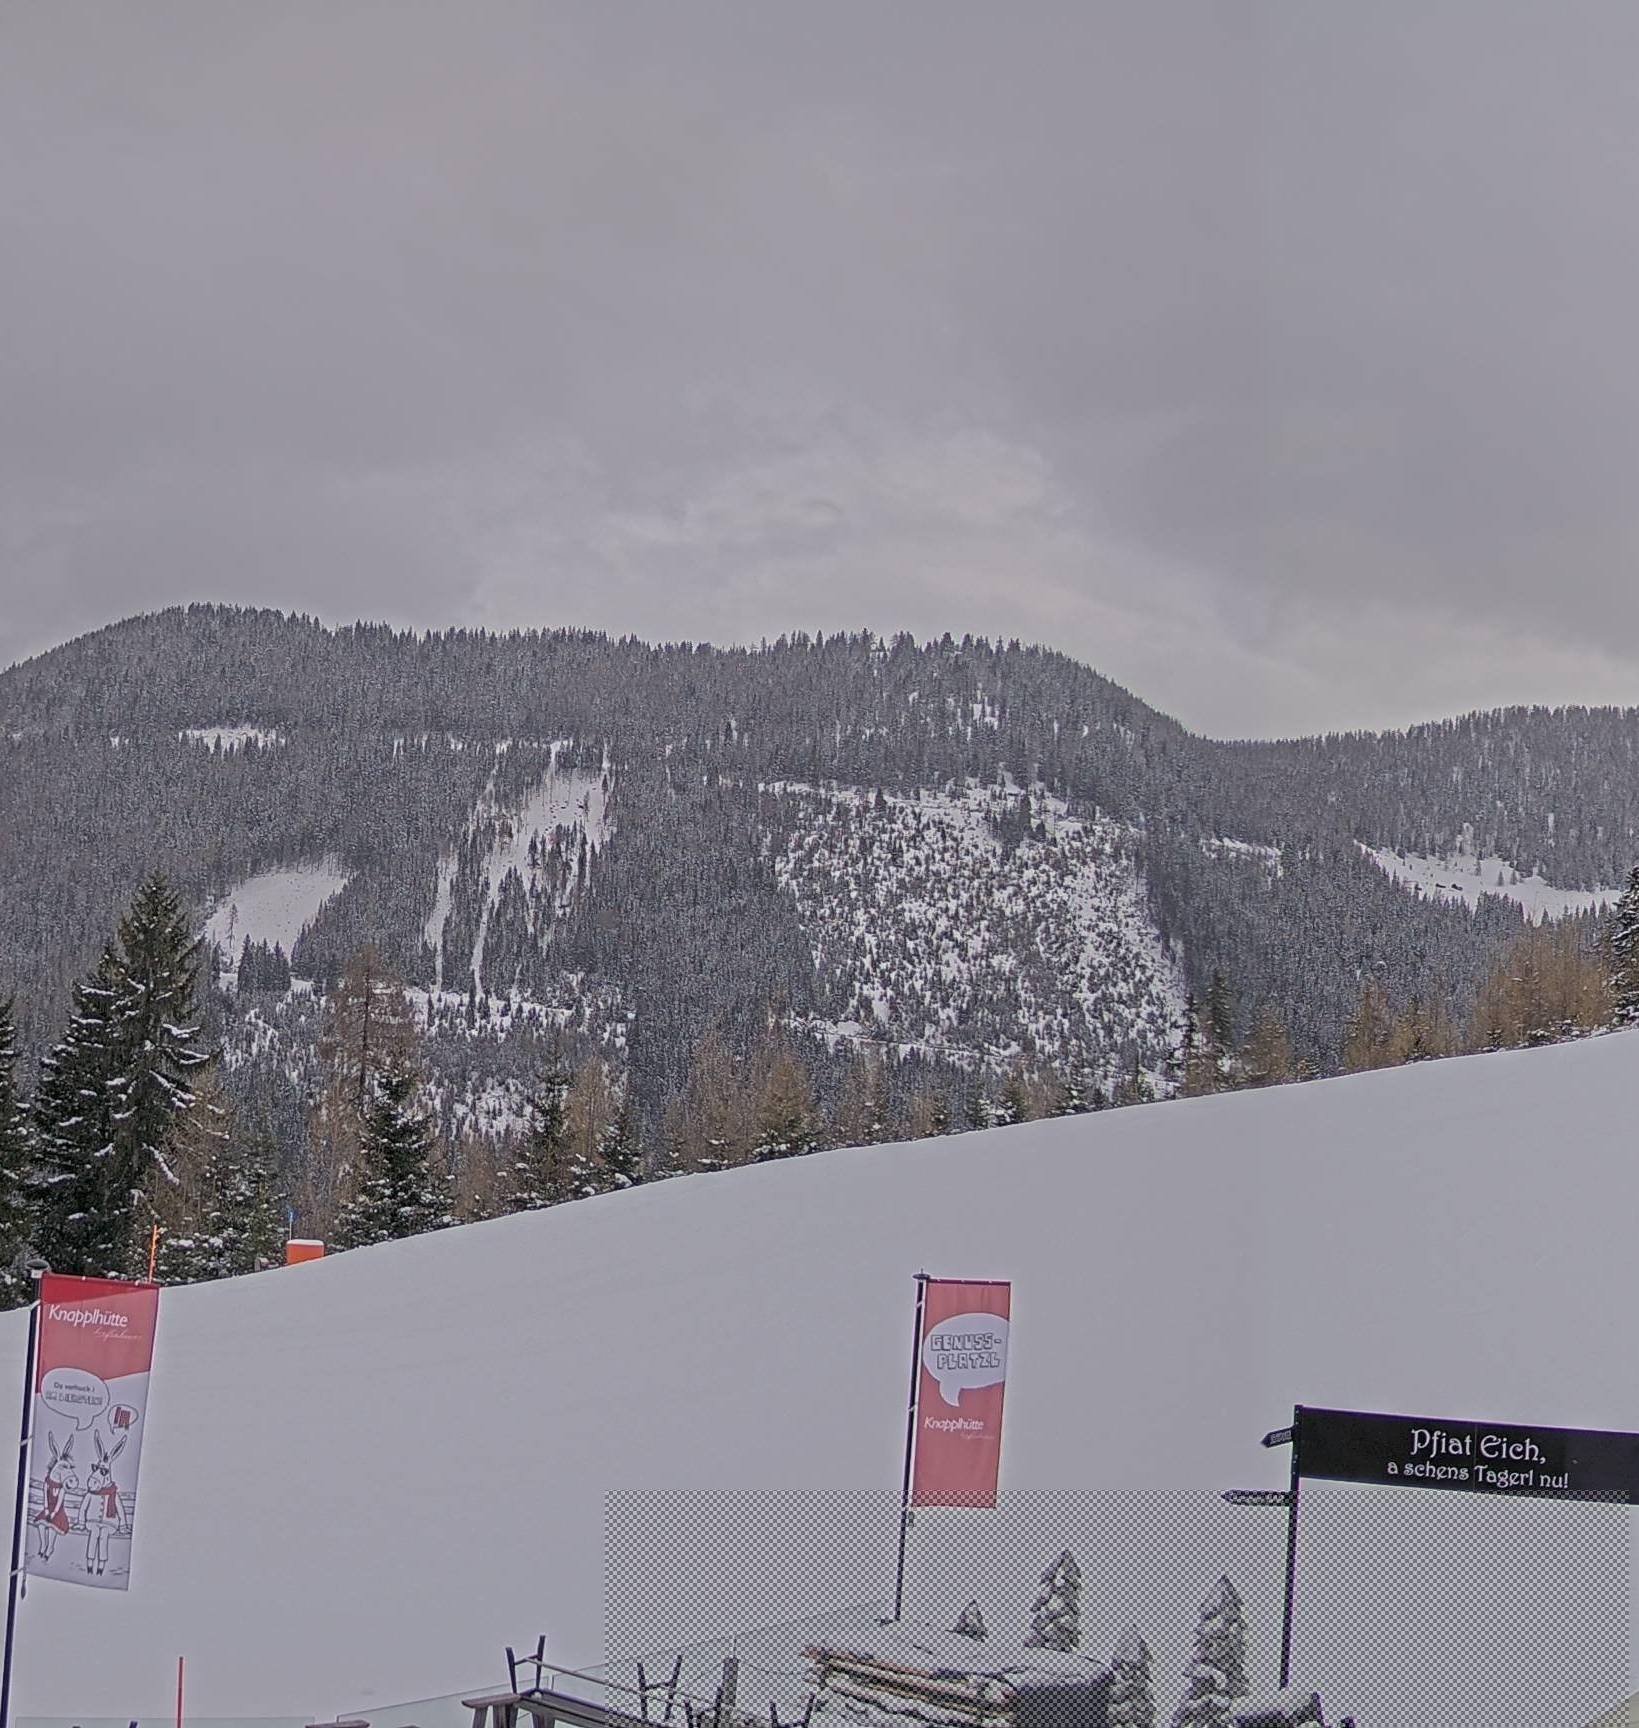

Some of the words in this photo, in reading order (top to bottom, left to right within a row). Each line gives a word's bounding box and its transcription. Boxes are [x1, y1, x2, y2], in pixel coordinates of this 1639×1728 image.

[49, 1304, 128, 1327] Knapplhütte
[931, 1333, 1002, 1351] GENUSS-
[937, 1352, 1000, 1370] PLATZL
[924, 1417, 984, 1432] Knapplhütte
[1410, 1429, 1472, 1458] Pfiat
[1480, 1434, 1547, 1464] Eich,
[1387, 1462, 1398, 1475] a
[1403, 1461, 1470, 1481] schens
[1474, 1465, 1534, 1488] Tagerl
[1539, 1472, 1570, 1489] nu!
